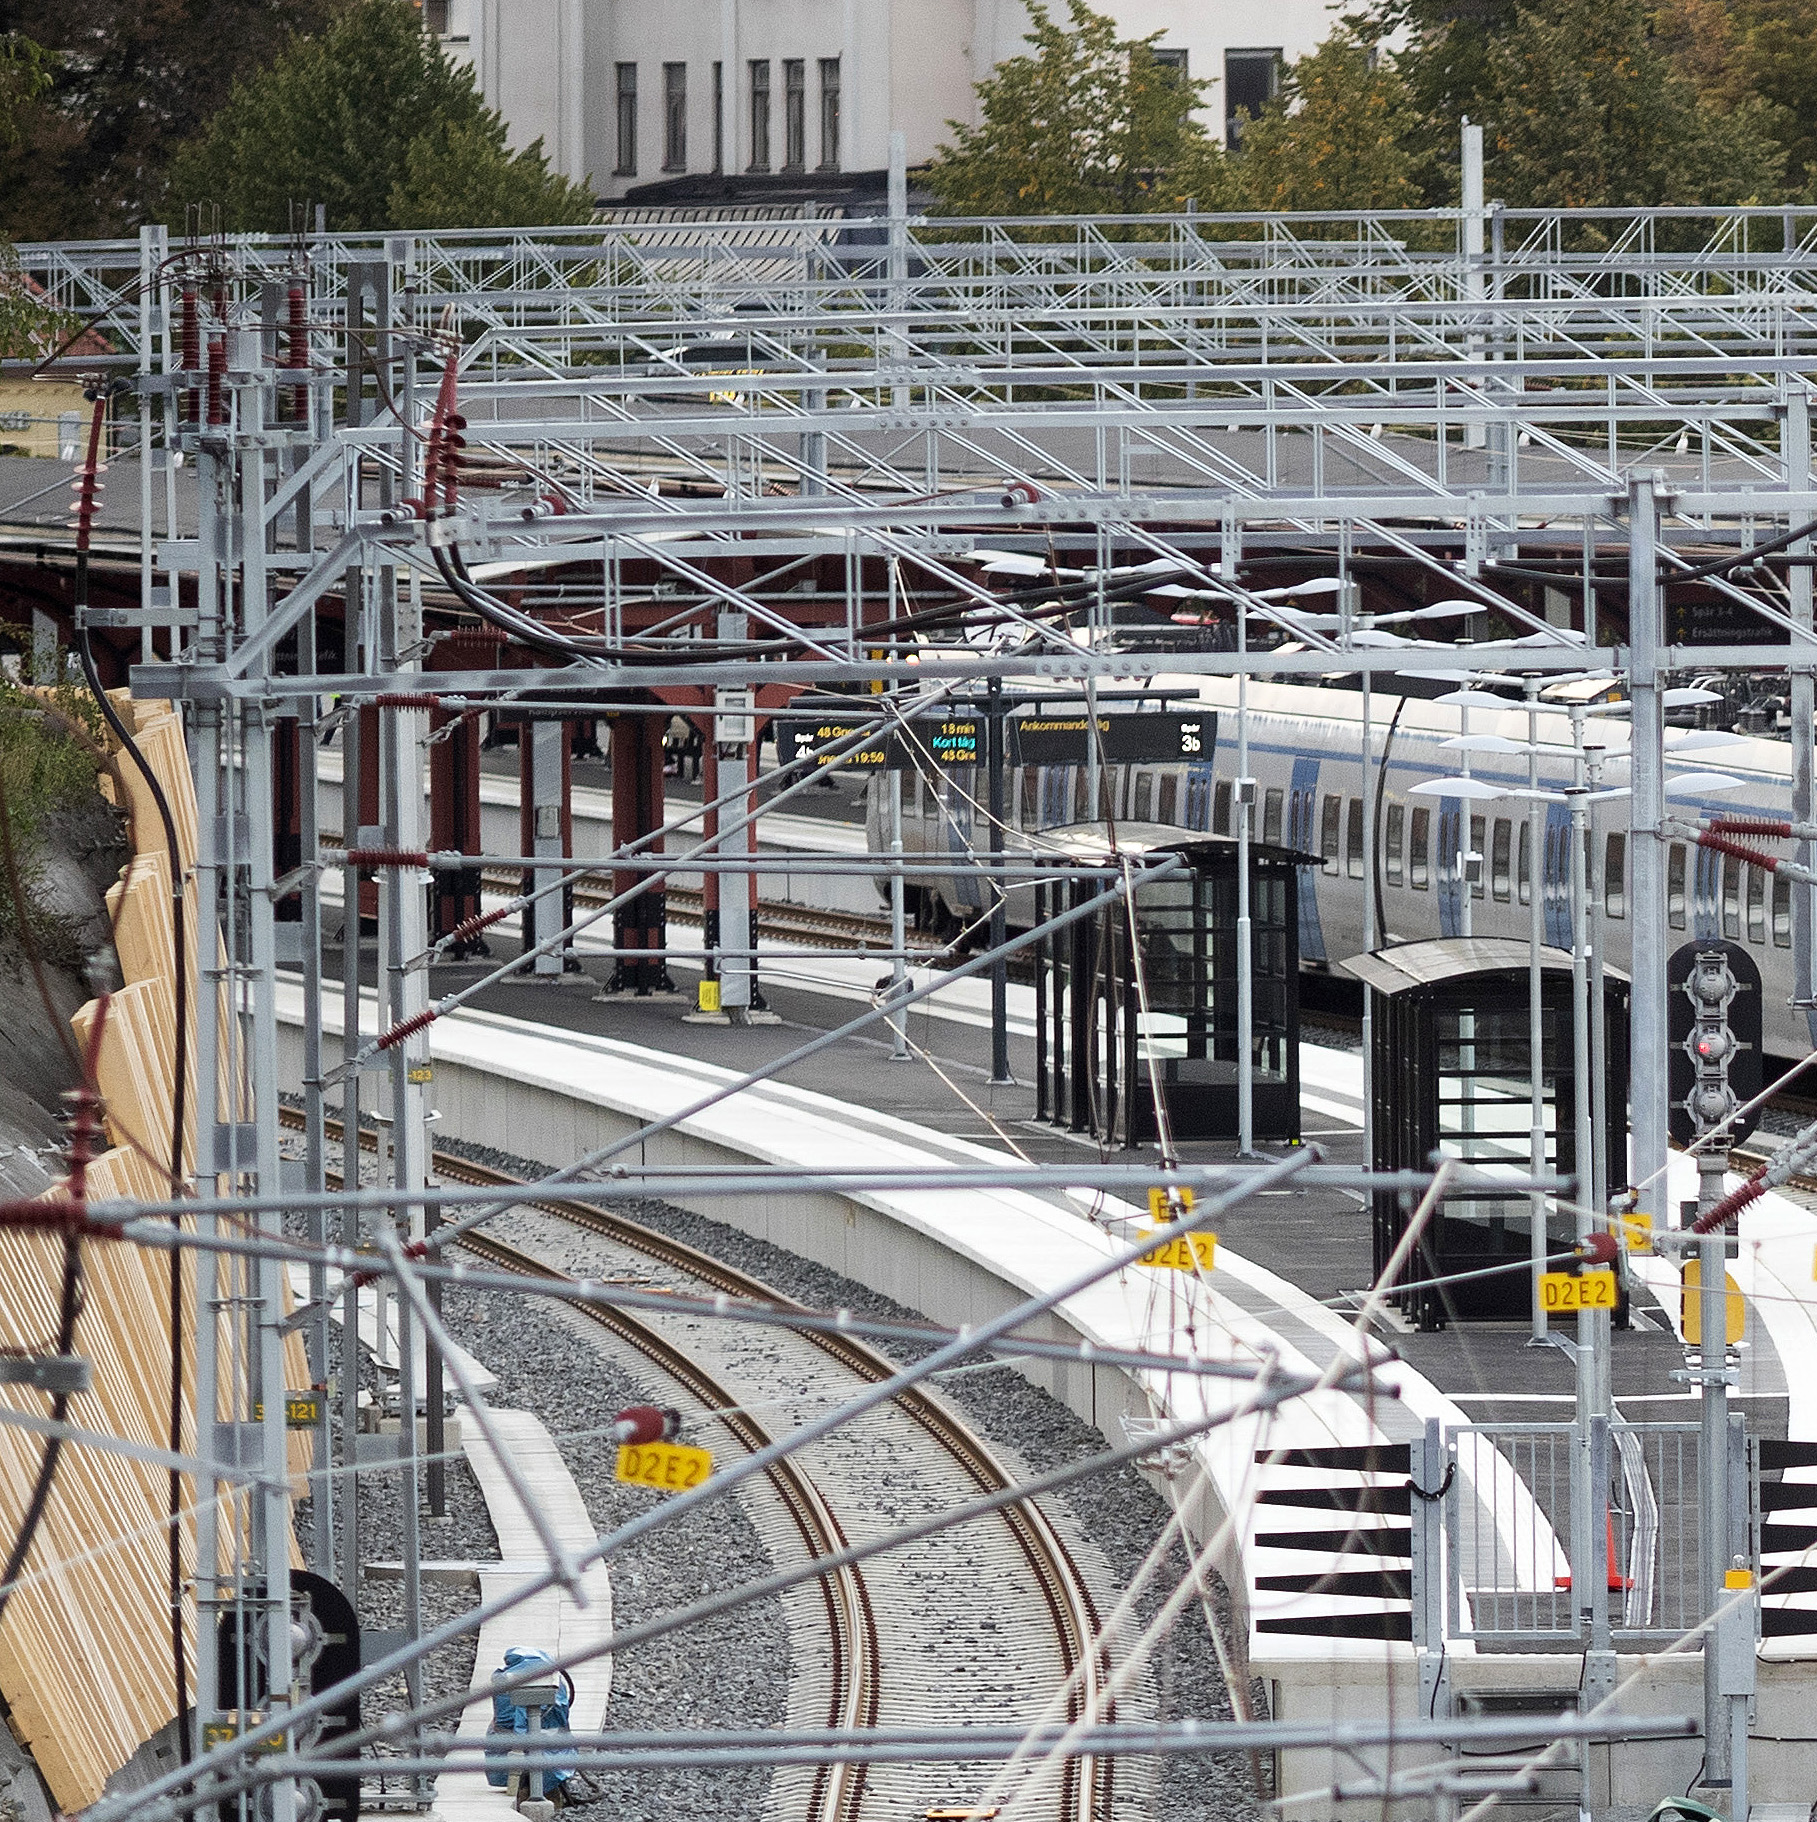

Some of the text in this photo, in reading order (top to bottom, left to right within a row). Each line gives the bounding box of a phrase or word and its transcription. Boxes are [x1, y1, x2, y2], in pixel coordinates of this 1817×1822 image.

[1181, 735, 1201, 752] 3b
[1545, 1282, 1607, 1306] D2E2
[624, 1447, 701, 1488] D2E2
